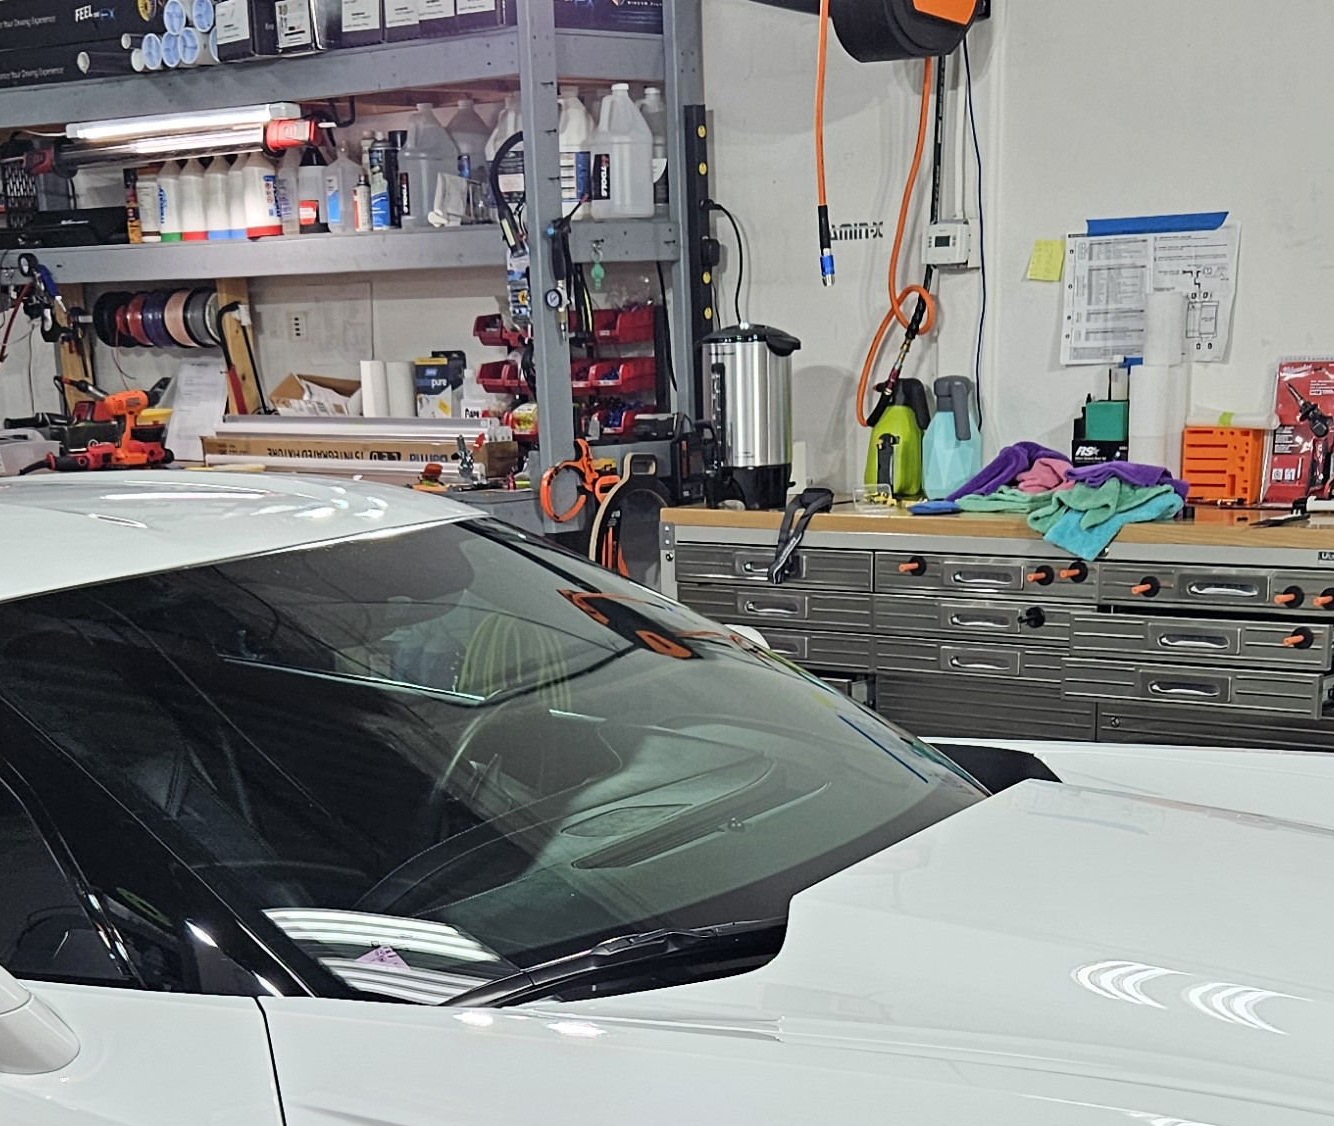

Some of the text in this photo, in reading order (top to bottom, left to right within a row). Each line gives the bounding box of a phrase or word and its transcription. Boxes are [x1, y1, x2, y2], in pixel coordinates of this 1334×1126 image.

[75, 4, 92, 23] FEEL
[600, 165, 609, 198] TOOLS
[830, 220, 884, 241] AMIN-X
